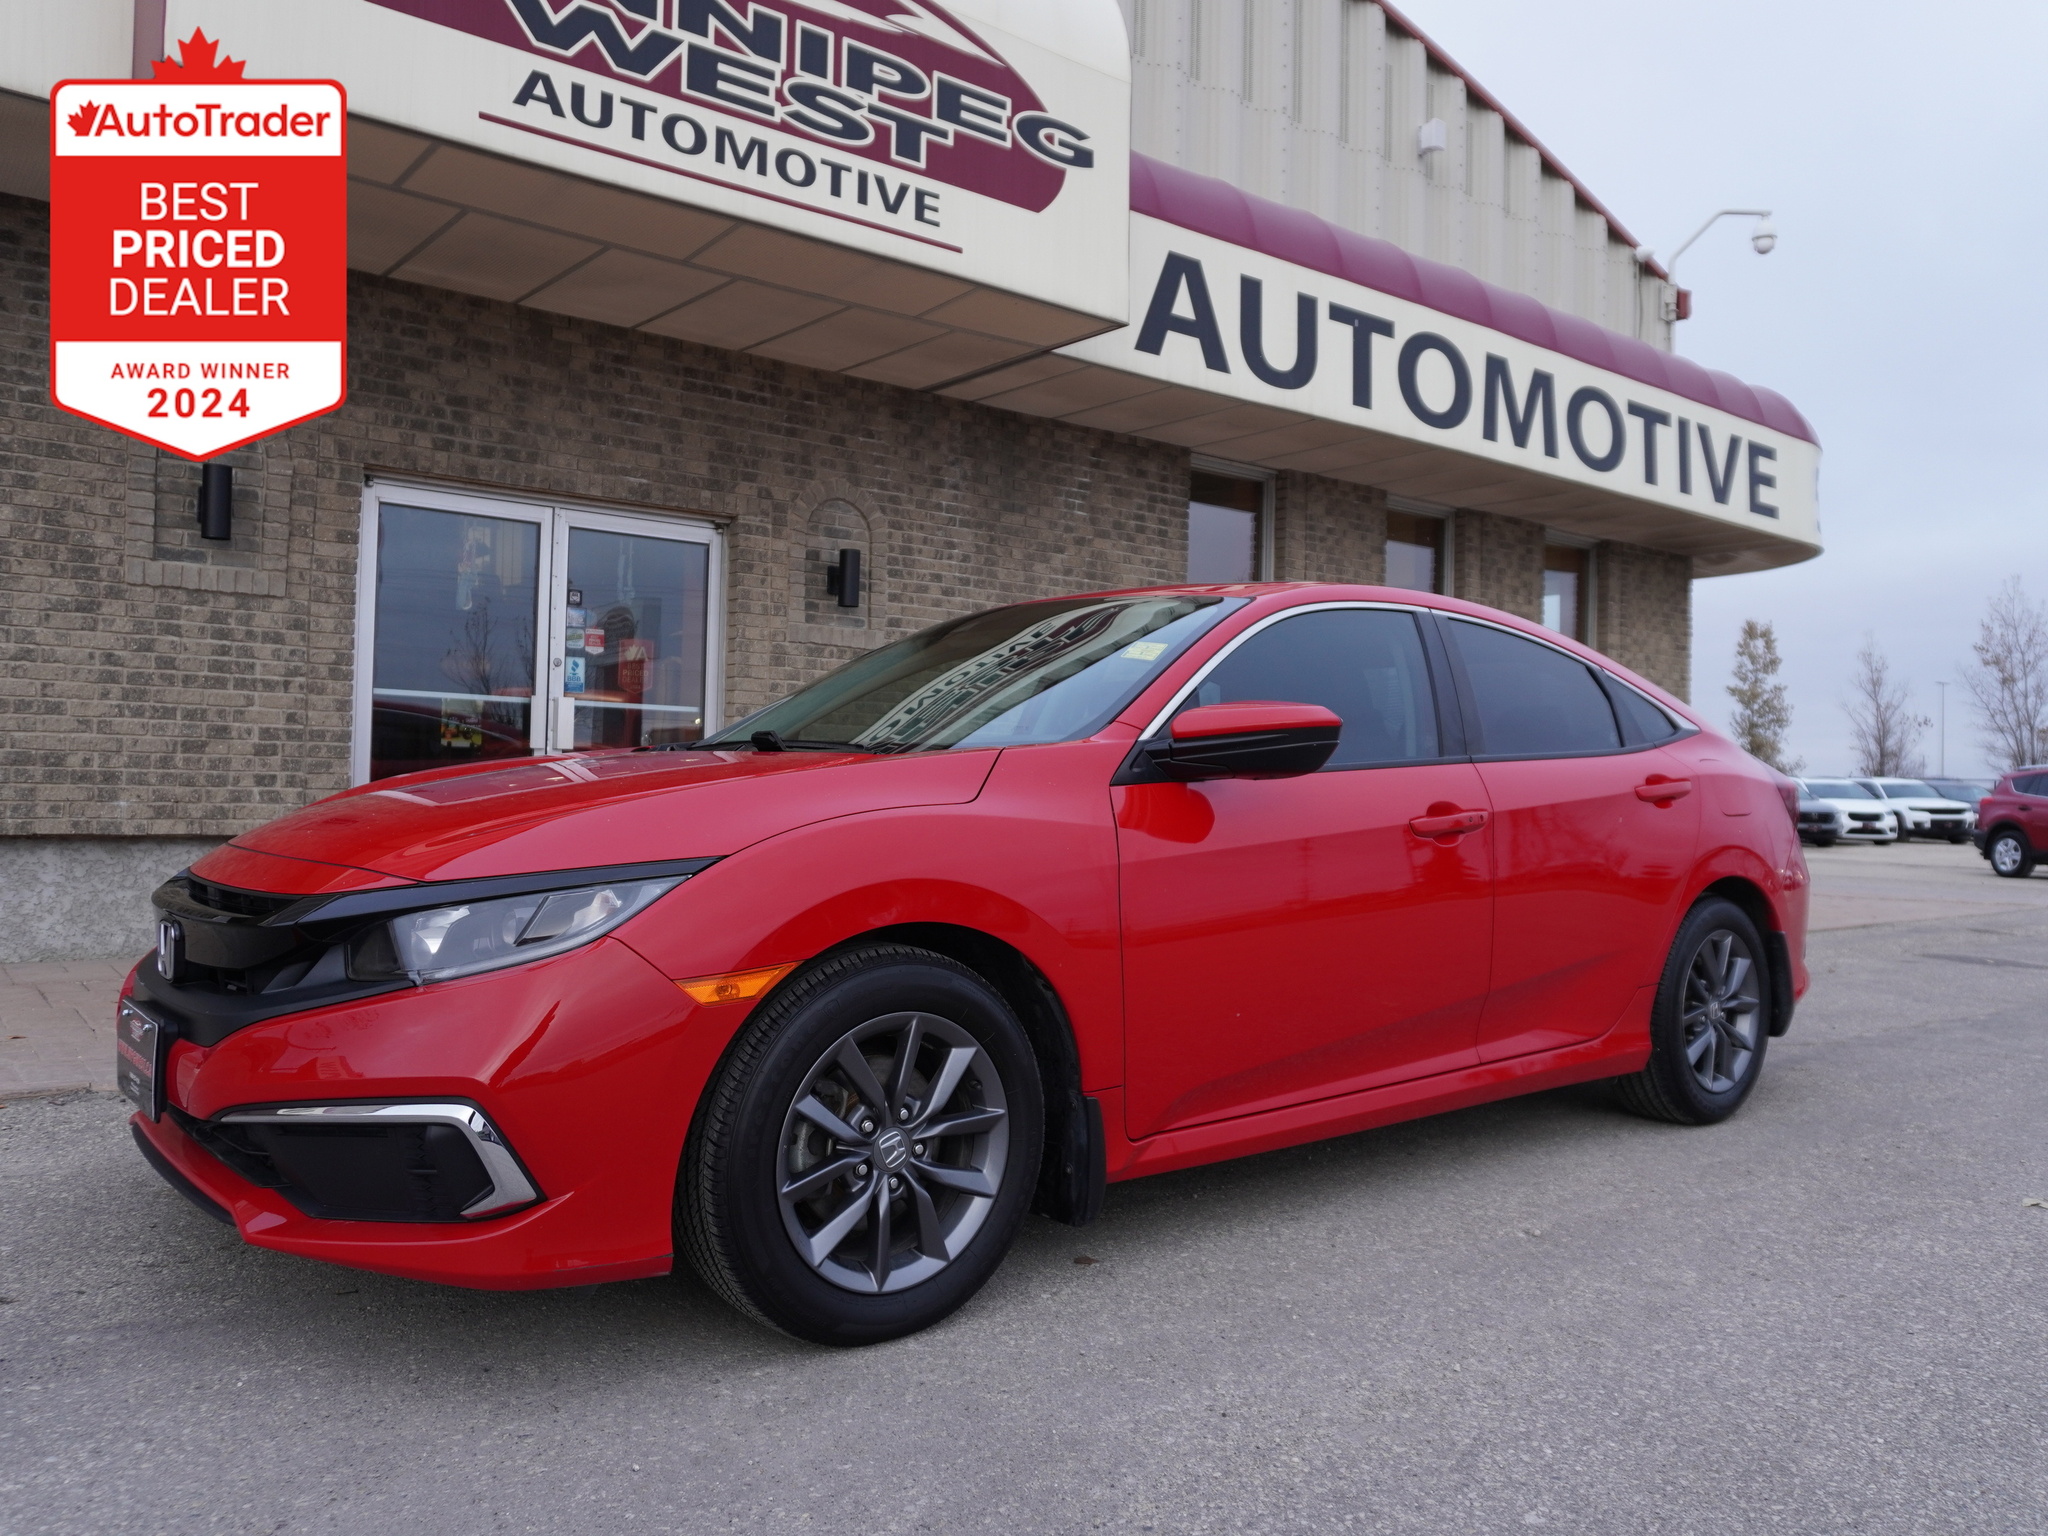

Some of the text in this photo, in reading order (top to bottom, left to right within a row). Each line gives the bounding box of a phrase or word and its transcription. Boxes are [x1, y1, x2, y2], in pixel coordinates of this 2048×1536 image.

[508, 0, 951, 166] WEST
[512, 69, 941, 228] AUTOMOTIVE
[1133, 249, 1780, 521] AUTOMOTIVE
